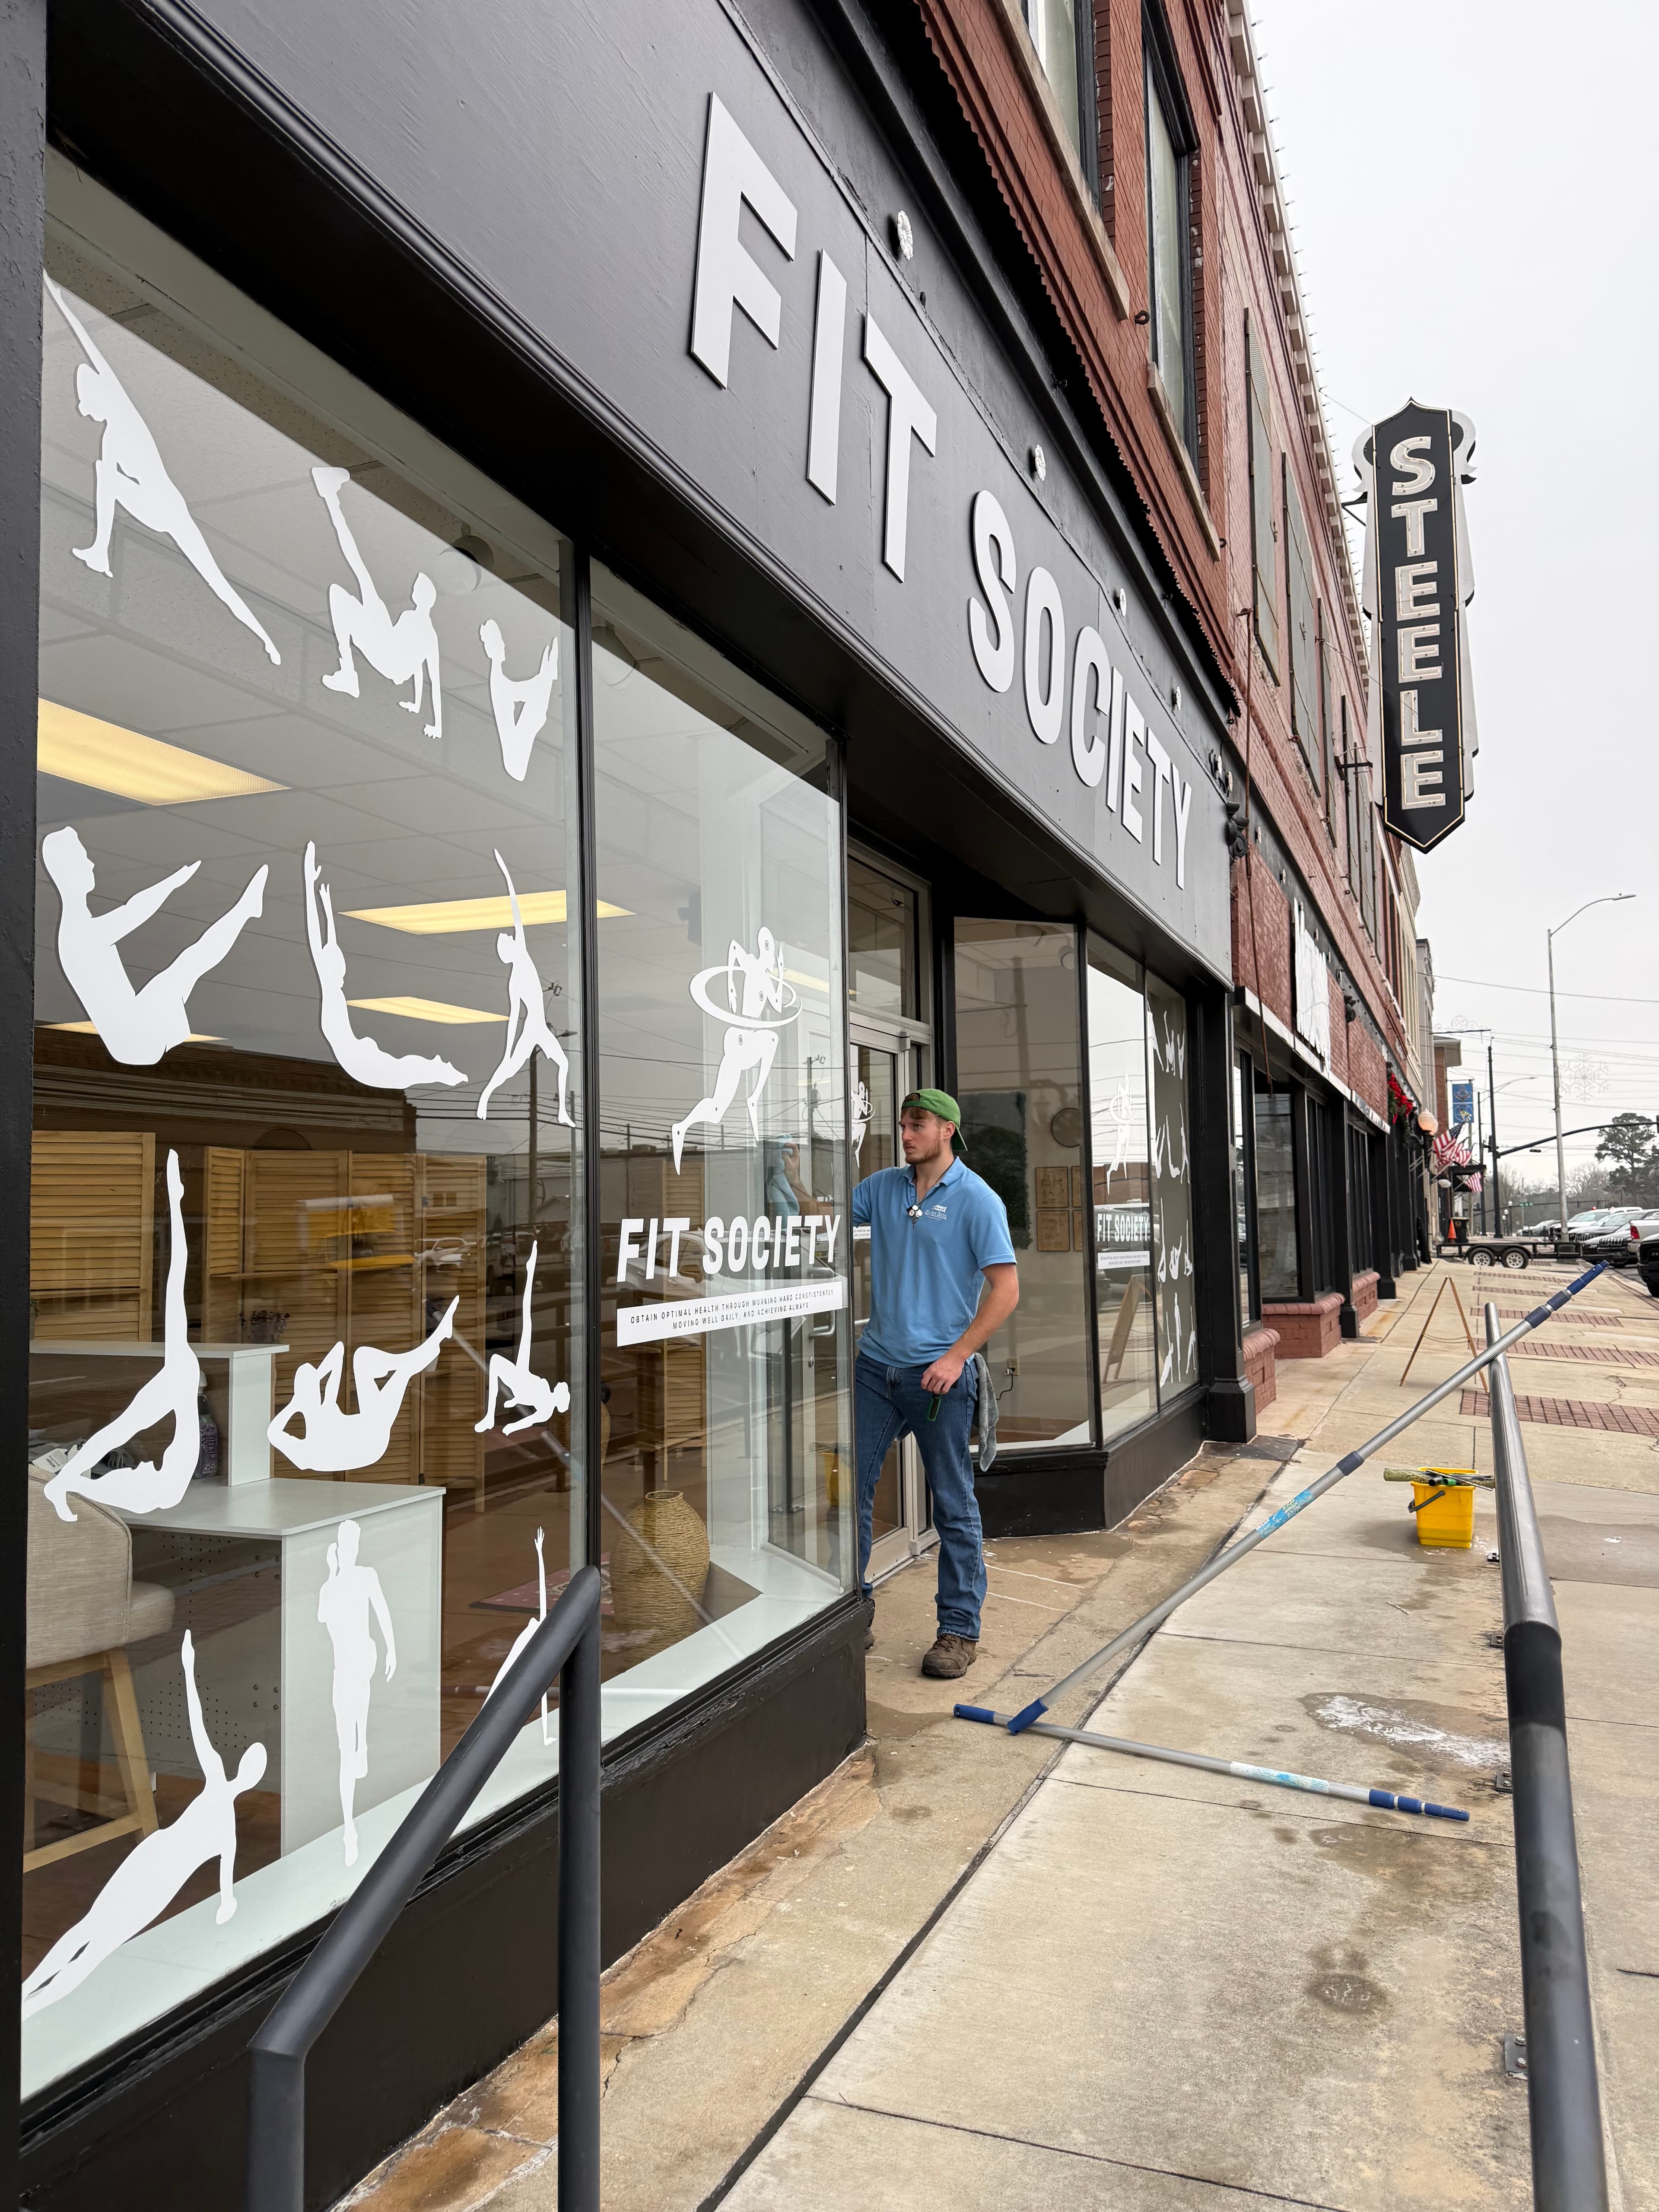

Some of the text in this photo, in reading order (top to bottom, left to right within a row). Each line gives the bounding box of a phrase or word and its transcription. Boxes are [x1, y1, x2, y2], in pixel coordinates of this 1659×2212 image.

[691, 90, 1192, 890] FIT SOCIETY
[1389, 436, 1446, 810] STEELE
[617, 1214, 841, 1282] FIT SOCIETY
[1097, 1213, 1148, 1241] FIT SOCIETY
[631, 1313, 657, 1323] OBTAIN
[661, 1309, 691, 1319] OPTIMAL
[695, 1305, 718, 1314] HEALTH
[722, 1300, 749, 1310] THROUGH
[752, 1297, 777, 1306] WORKING
[673, 1319, 699, 1329] MOVING
[702, 1316, 718, 1324] WELL
[721, 1313, 740, 1321] DAILY,
[758, 1306, 786, 1315] ACHIEVING
[789, 1303, 808, 1311] ALWAYS
